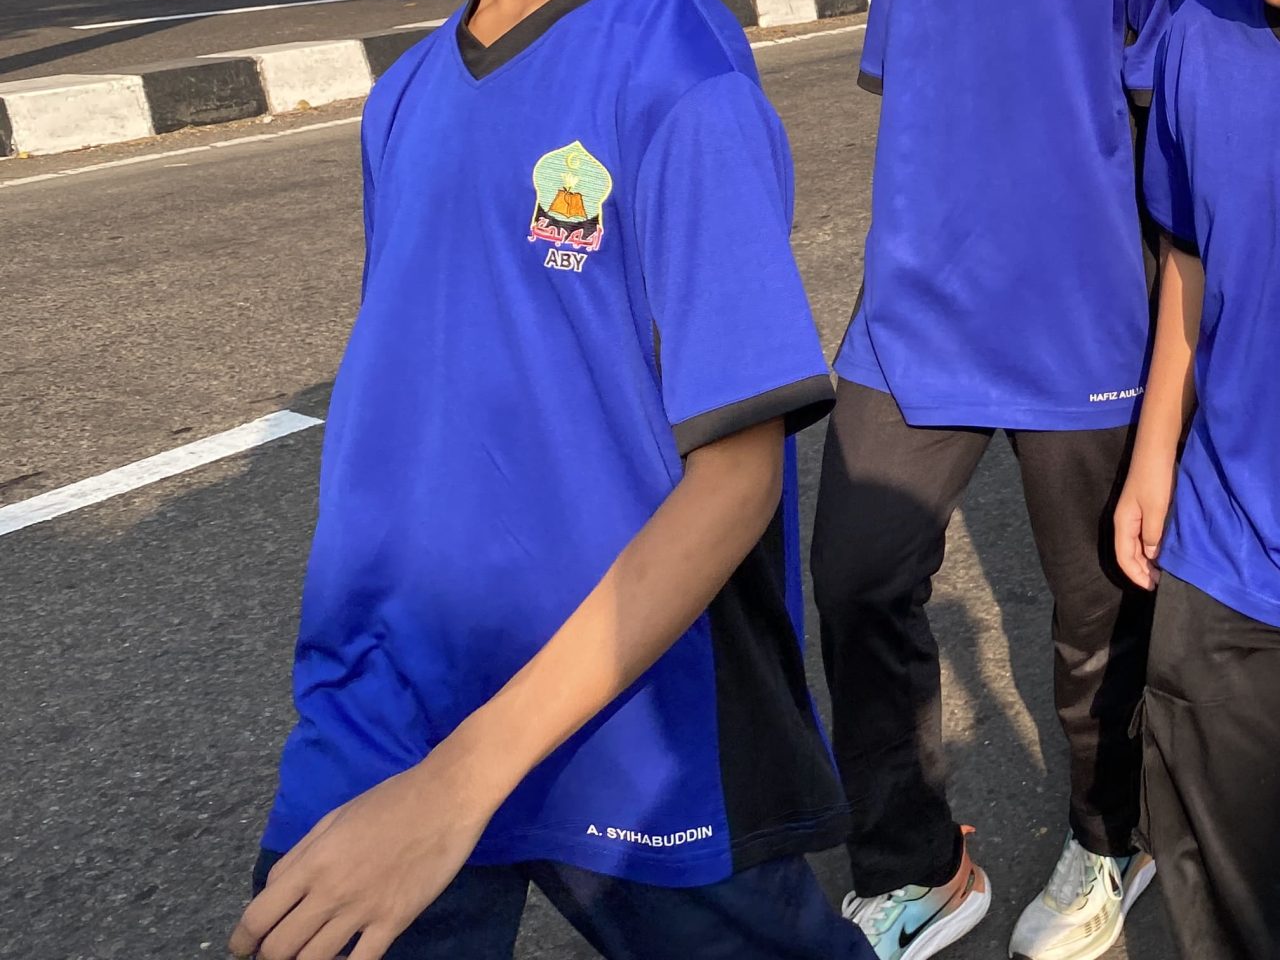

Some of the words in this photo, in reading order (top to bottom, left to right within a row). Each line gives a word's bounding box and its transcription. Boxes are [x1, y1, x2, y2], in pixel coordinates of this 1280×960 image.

[544, 248, 588, 272] ABY
[1089, 391, 1118, 402] HAFIZ
[586, 824, 603, 836] A.
[606, 825, 713, 847] SYIHABUDDIN
